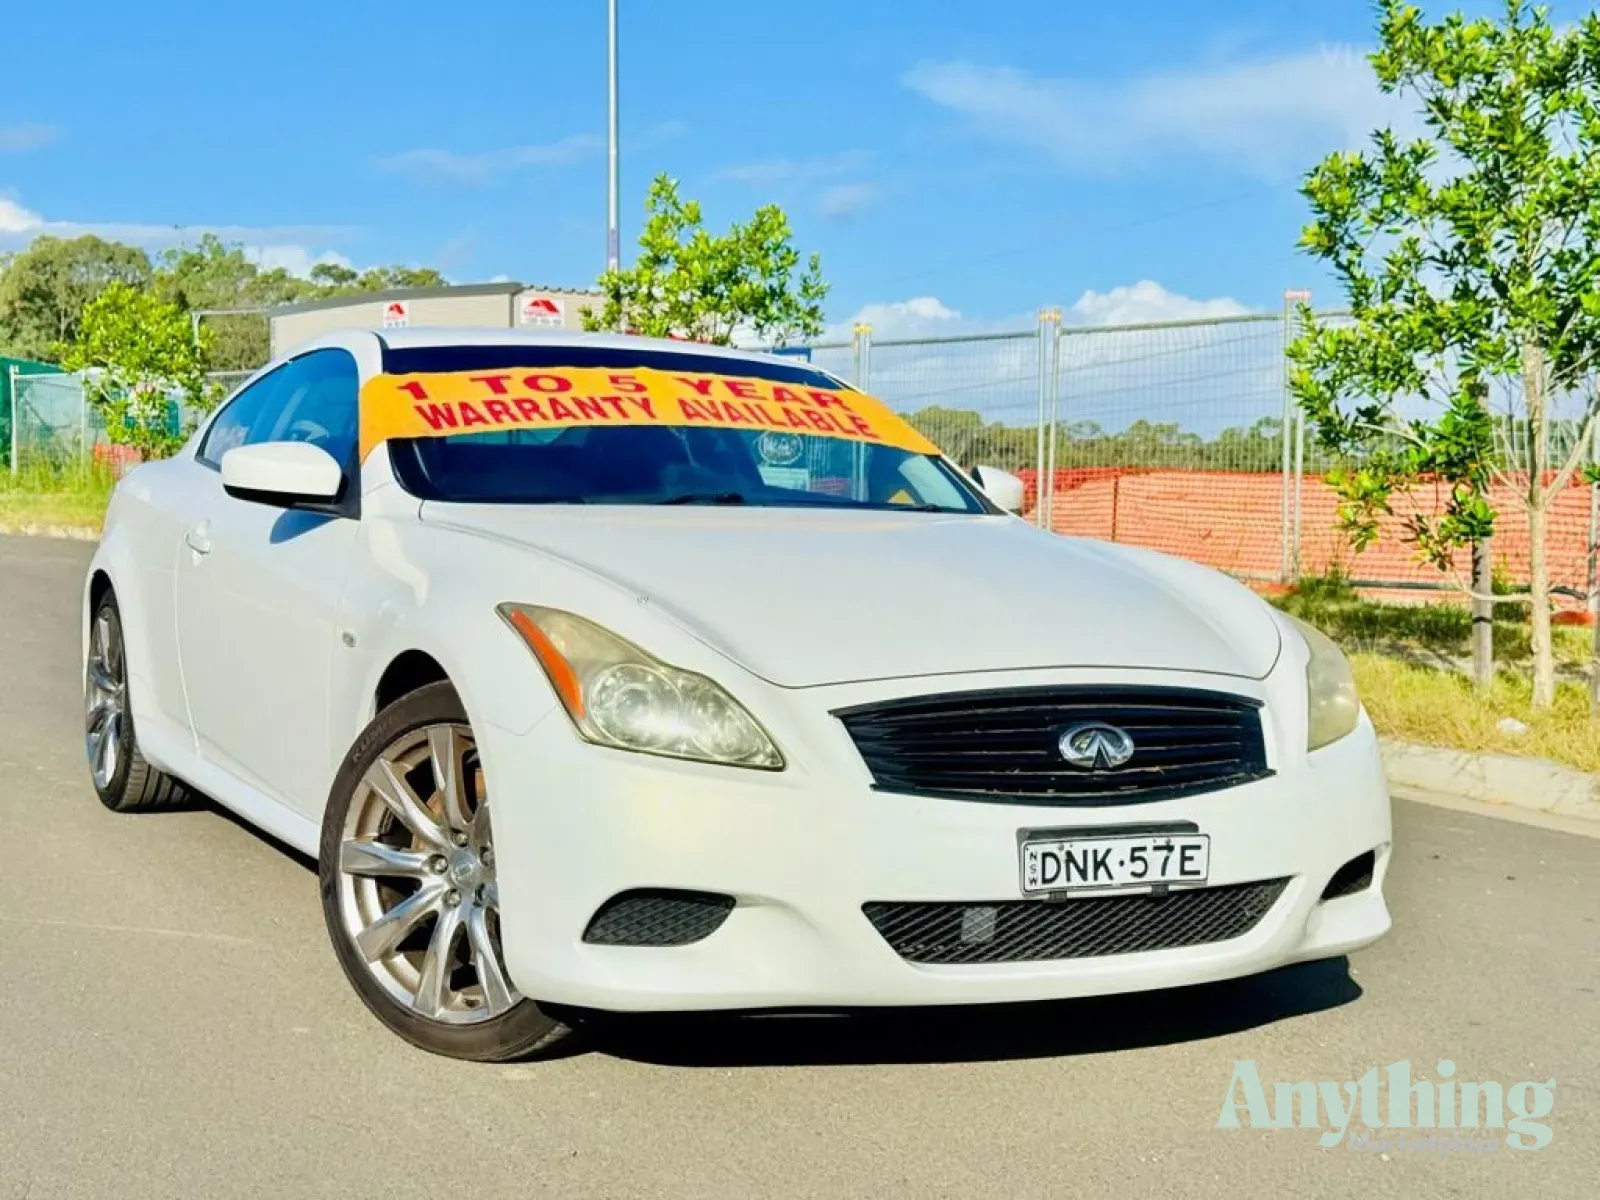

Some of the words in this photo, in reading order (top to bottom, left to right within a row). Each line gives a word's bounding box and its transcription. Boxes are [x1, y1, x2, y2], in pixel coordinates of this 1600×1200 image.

[397, 381, 428, 401] 1
[469, 375, 573, 395] TO
[608, 375, 648, 393] 5
[674, 377, 857, 413] YEAR
[414, 396, 659, 430] WARRANTY
[678, 399, 881, 439] AVAILABLE
